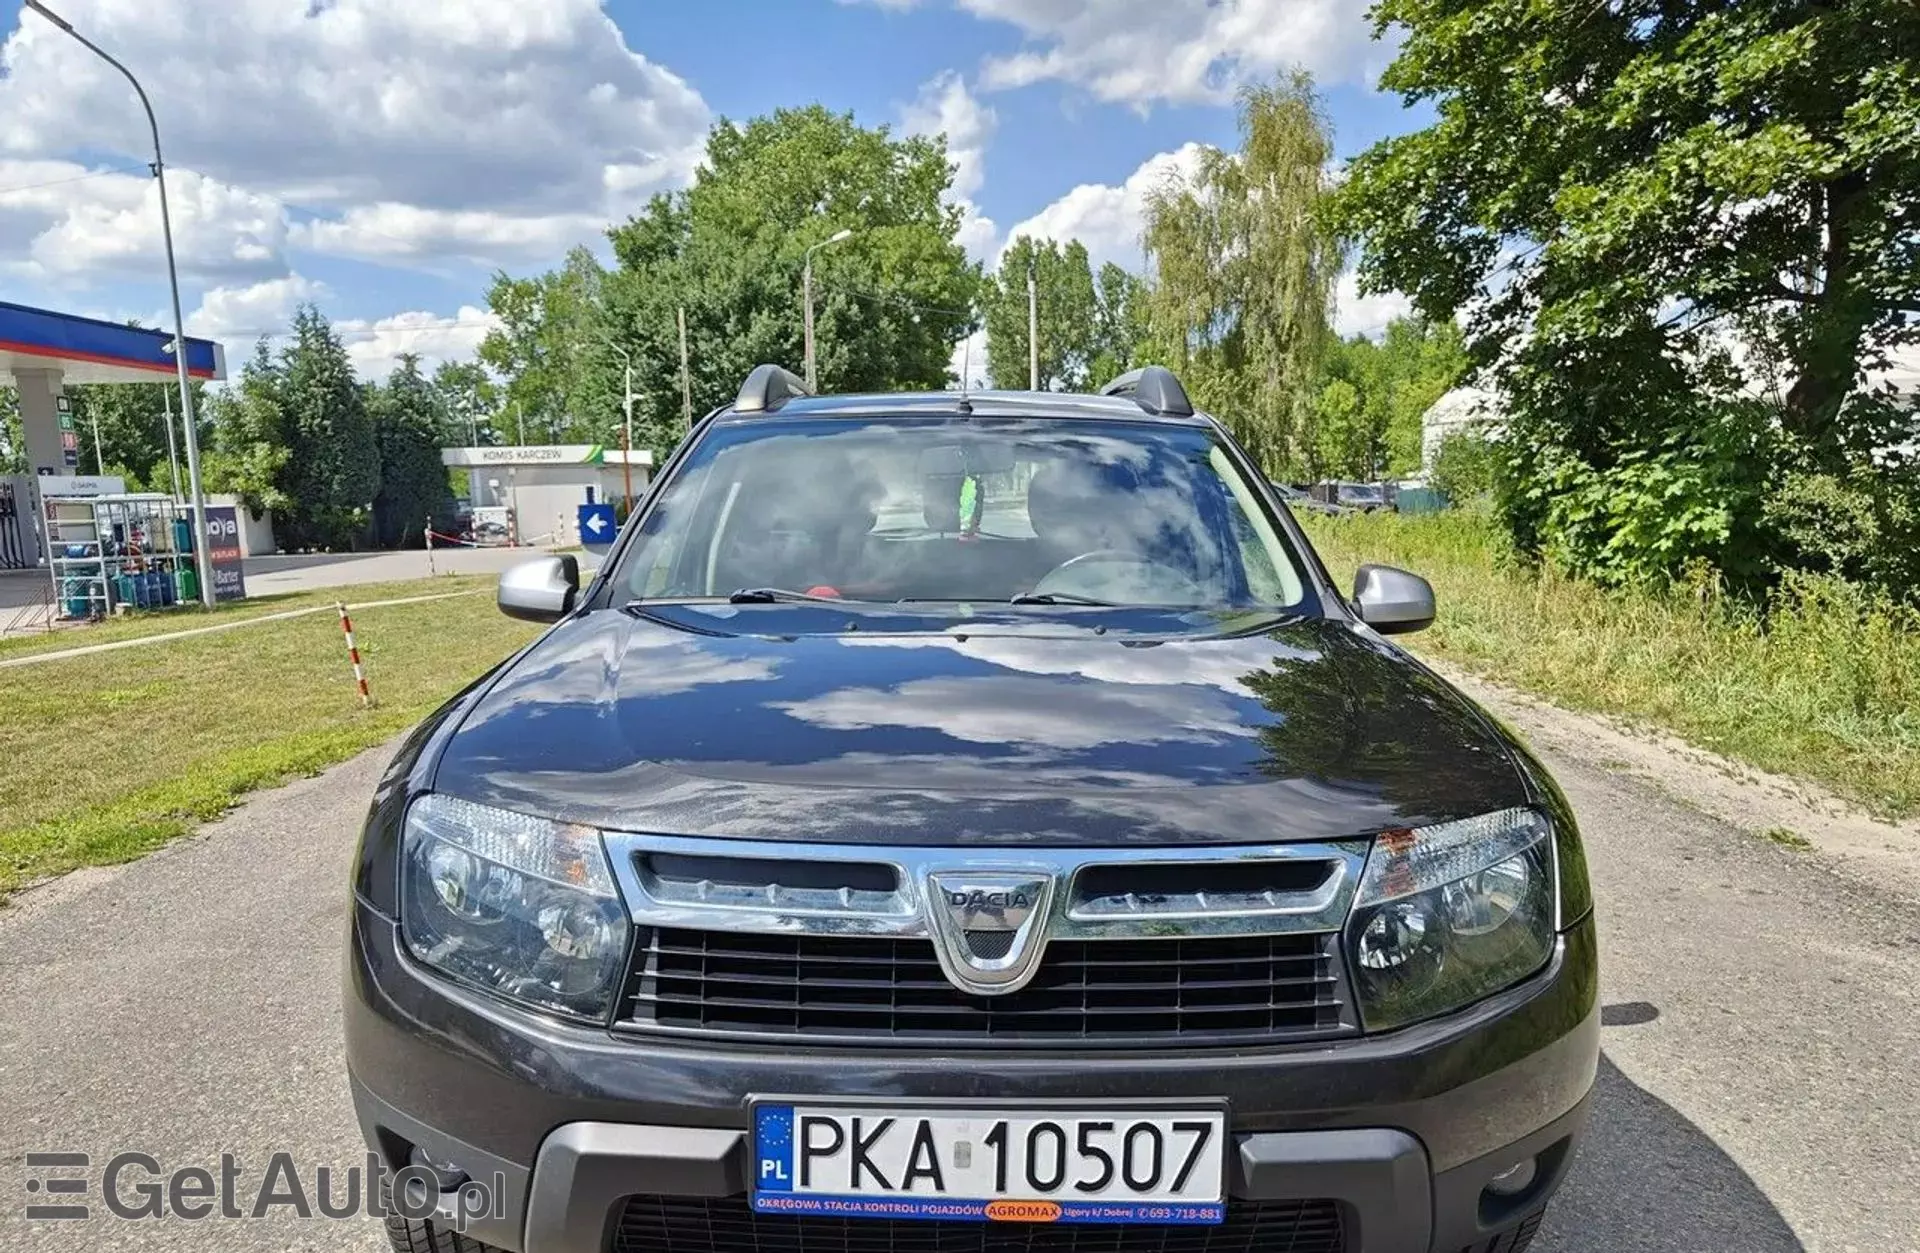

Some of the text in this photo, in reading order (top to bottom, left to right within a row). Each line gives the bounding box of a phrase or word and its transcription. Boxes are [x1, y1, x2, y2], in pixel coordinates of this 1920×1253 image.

[483, 449, 562, 461] KOMIS KARCZEW
[951, 889, 1029, 907] DACIA
[801, 1116, 1212, 1192] PKA 10507
[762, 1159, 788, 1179] PL
[757, 1198, 983, 1215] OKRĘGOWA STACJA KONTROLI POJAZDÓW
[988, 1206, 1059, 1217] AGROMAX
[1104, 1209, 1134, 1218] Dobrej
[1150, 1208, 1221, 1220] 693-718-881
